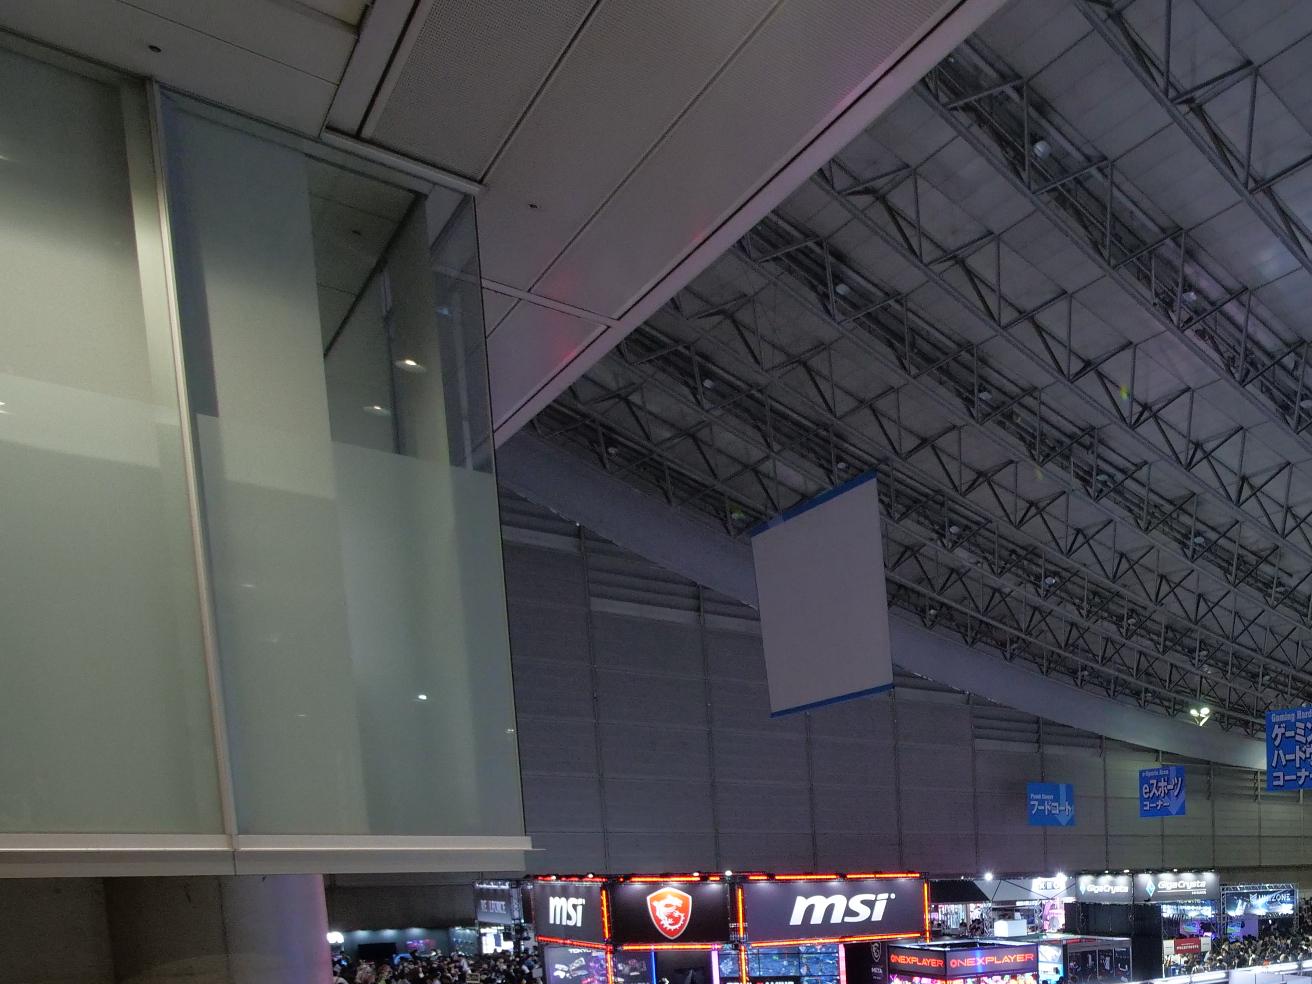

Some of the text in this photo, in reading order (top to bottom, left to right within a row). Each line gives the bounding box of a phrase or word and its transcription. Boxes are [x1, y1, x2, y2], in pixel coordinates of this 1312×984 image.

[1272, 713, 1295, 722] Gaming
[1142, 777, 1182, 798] eスポーツ
[1030, 801, 1072, 816] フードコート
[1143, 801, 1170, 811] コーナー
[789, 893, 889, 926] msi
[890, 954, 945, 968] ONEXPLAYER
[950, 953, 1035, 968] ONEXPLAYER
